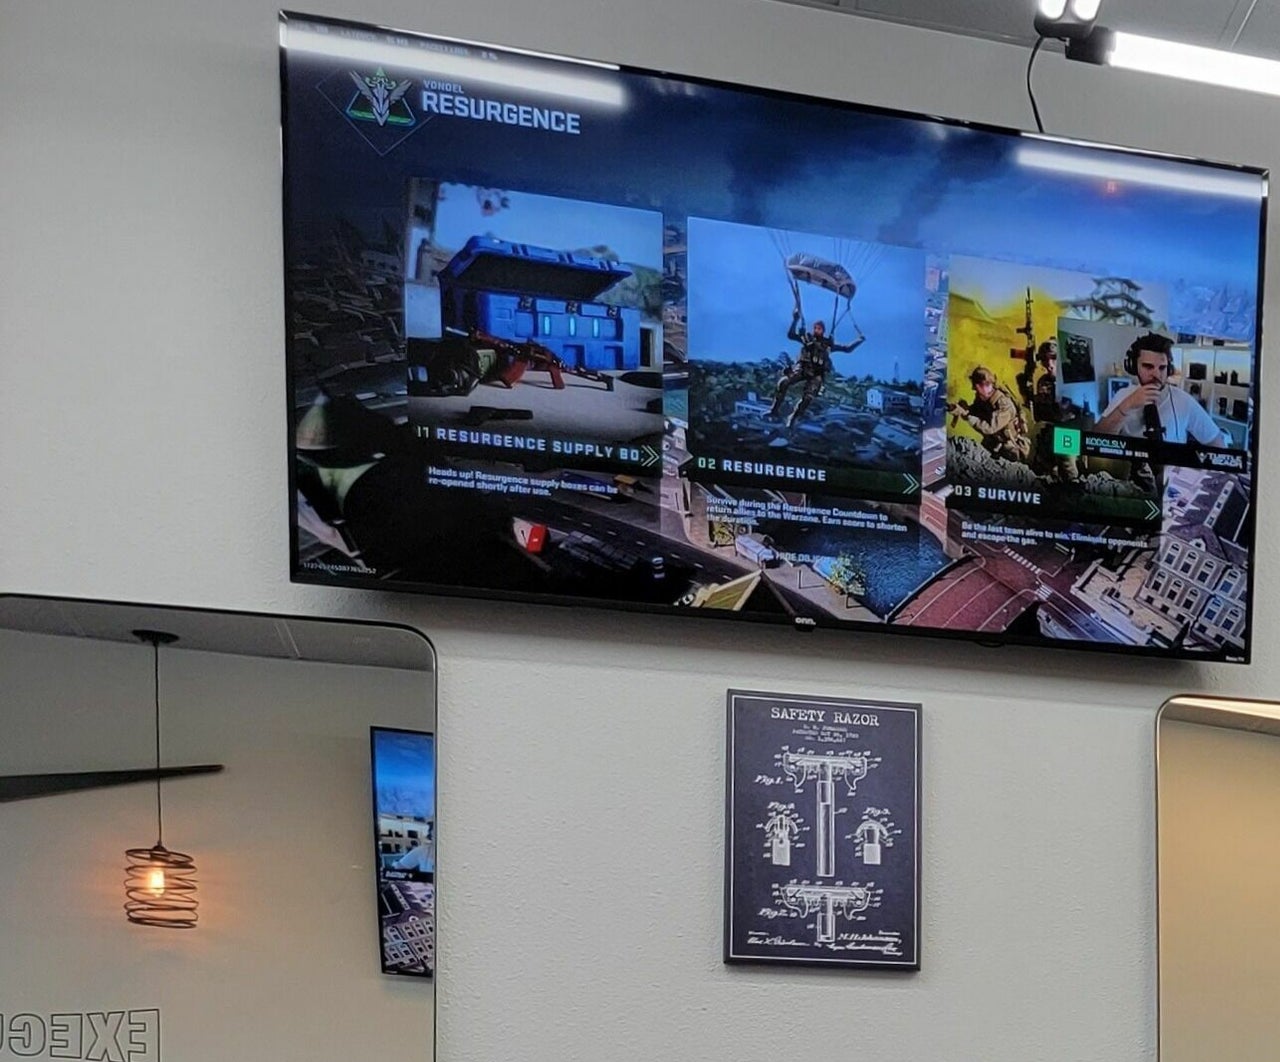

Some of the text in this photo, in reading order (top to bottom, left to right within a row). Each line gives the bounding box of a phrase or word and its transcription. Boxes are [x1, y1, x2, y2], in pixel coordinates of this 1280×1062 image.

[422, 91, 581, 134] RESURGENCE
[436, 428, 546, 451] RESURGENCE
[552, 440, 613, 458] SUPPLY
[428, 466, 457, 477] Heads
[475, 471, 529, 485] Resurgence
[530, 477, 559, 489] supply
[698, 457, 827, 482] 02 RESURGENCE
[476, 481, 508, 493] shortly
[510, 484, 531, 494] after
[955, 485, 1041, 505] 03 SURVIVE
[783, 502, 832, 515] Resurgence
[832, 508, 878, 520] Countdown
[770, 706, 880, 727] SAFETY RAZOR
